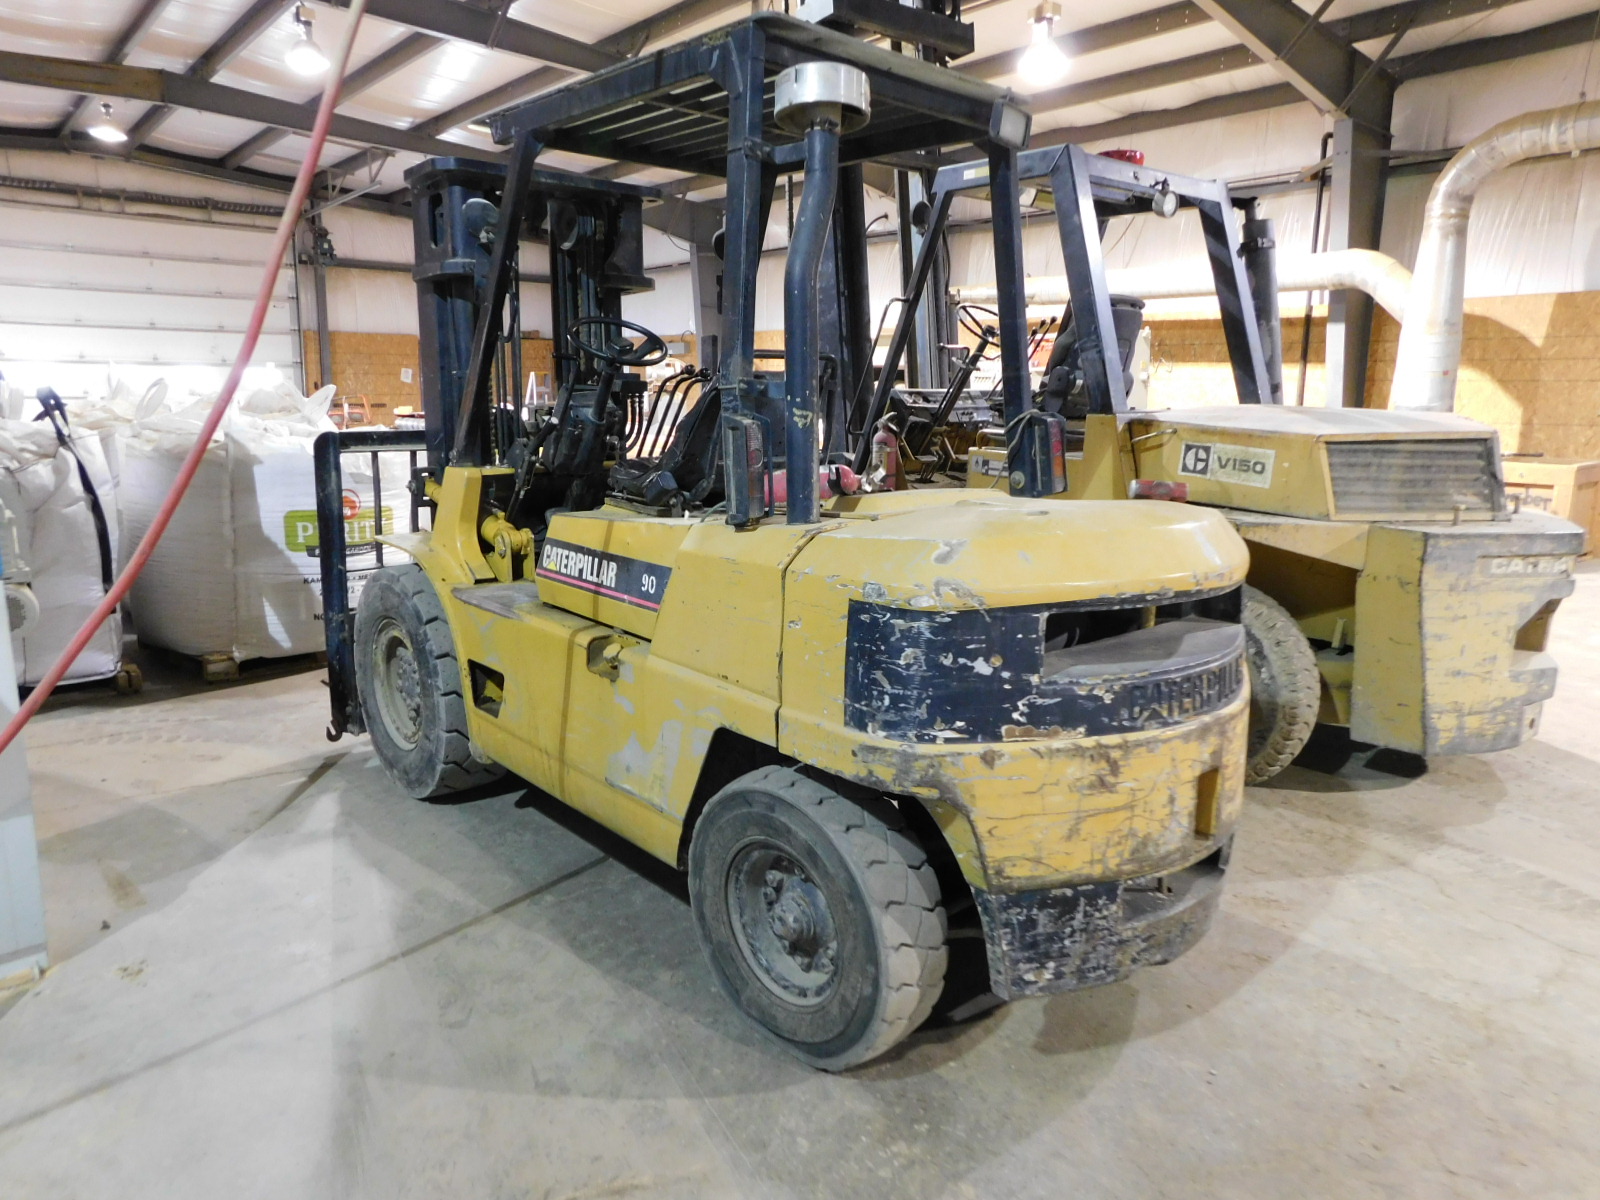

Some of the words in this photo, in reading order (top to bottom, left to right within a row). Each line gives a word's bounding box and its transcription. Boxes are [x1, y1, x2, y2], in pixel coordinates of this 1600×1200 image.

[1217, 455, 1266, 475] V150
[542, 544, 617, 588] CATERPILLAR
[641, 573, 656, 594] 90
